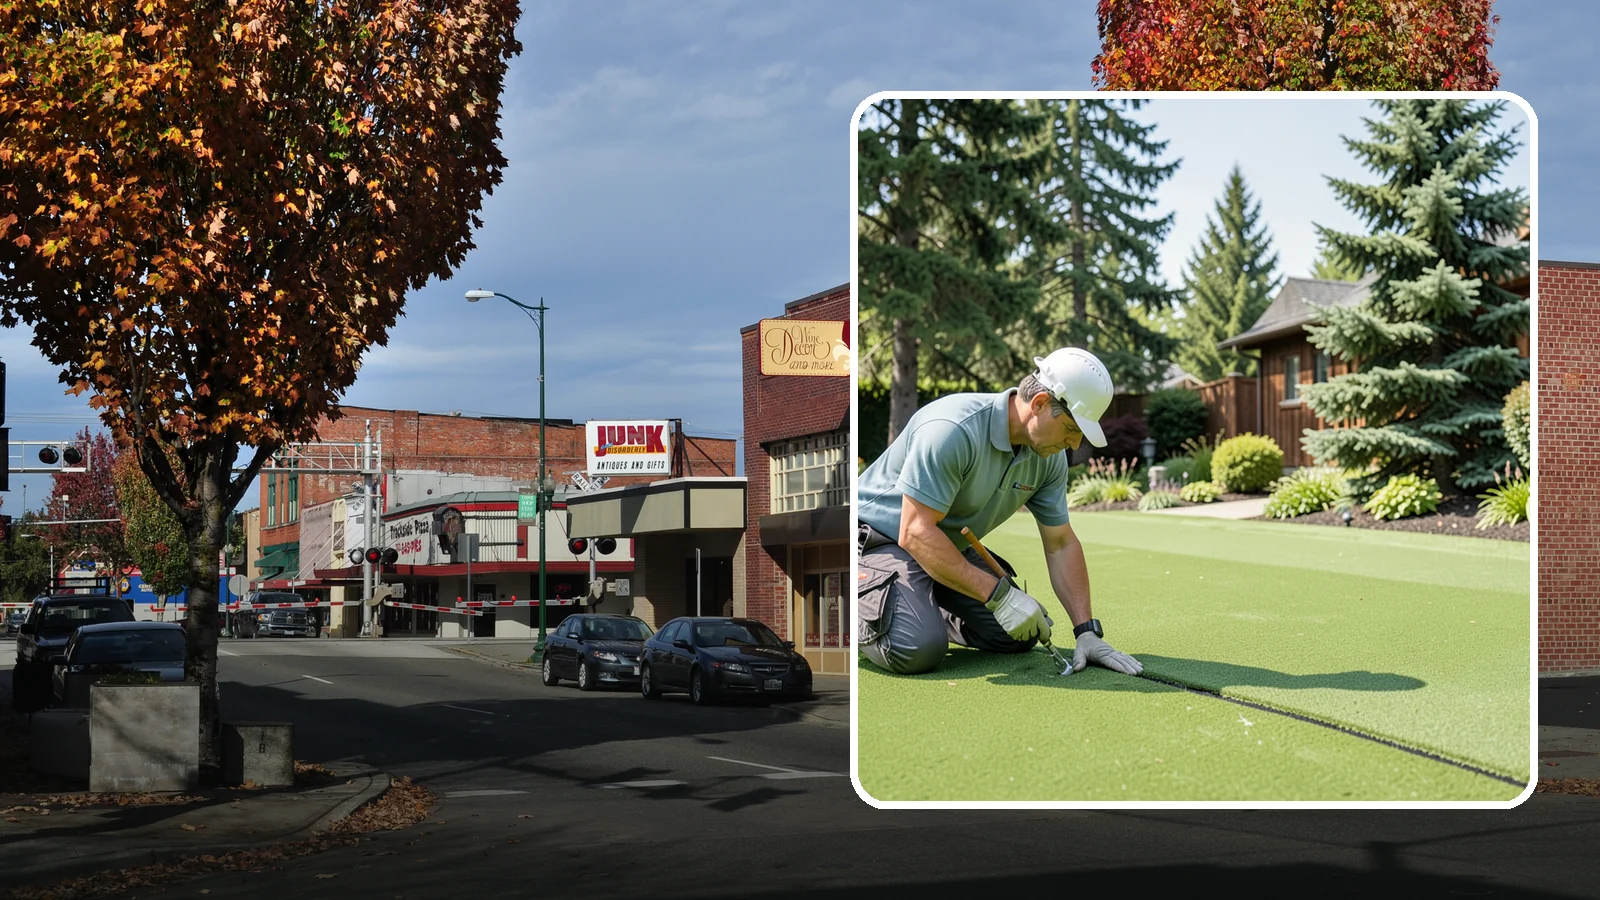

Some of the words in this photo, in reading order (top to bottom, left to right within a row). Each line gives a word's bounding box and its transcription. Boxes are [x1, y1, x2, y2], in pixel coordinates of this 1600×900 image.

[595, 426, 664, 457] JUNK
[607, 446, 646, 454] DISORDERLY
[597, 461, 628, 469] ANTIQUES
[631, 461, 644, 469] AND
[647, 461, 665, 469] GIFTS
[390, 521, 413, 539] Trackside
[414, 519, 429, 534] Pizza
